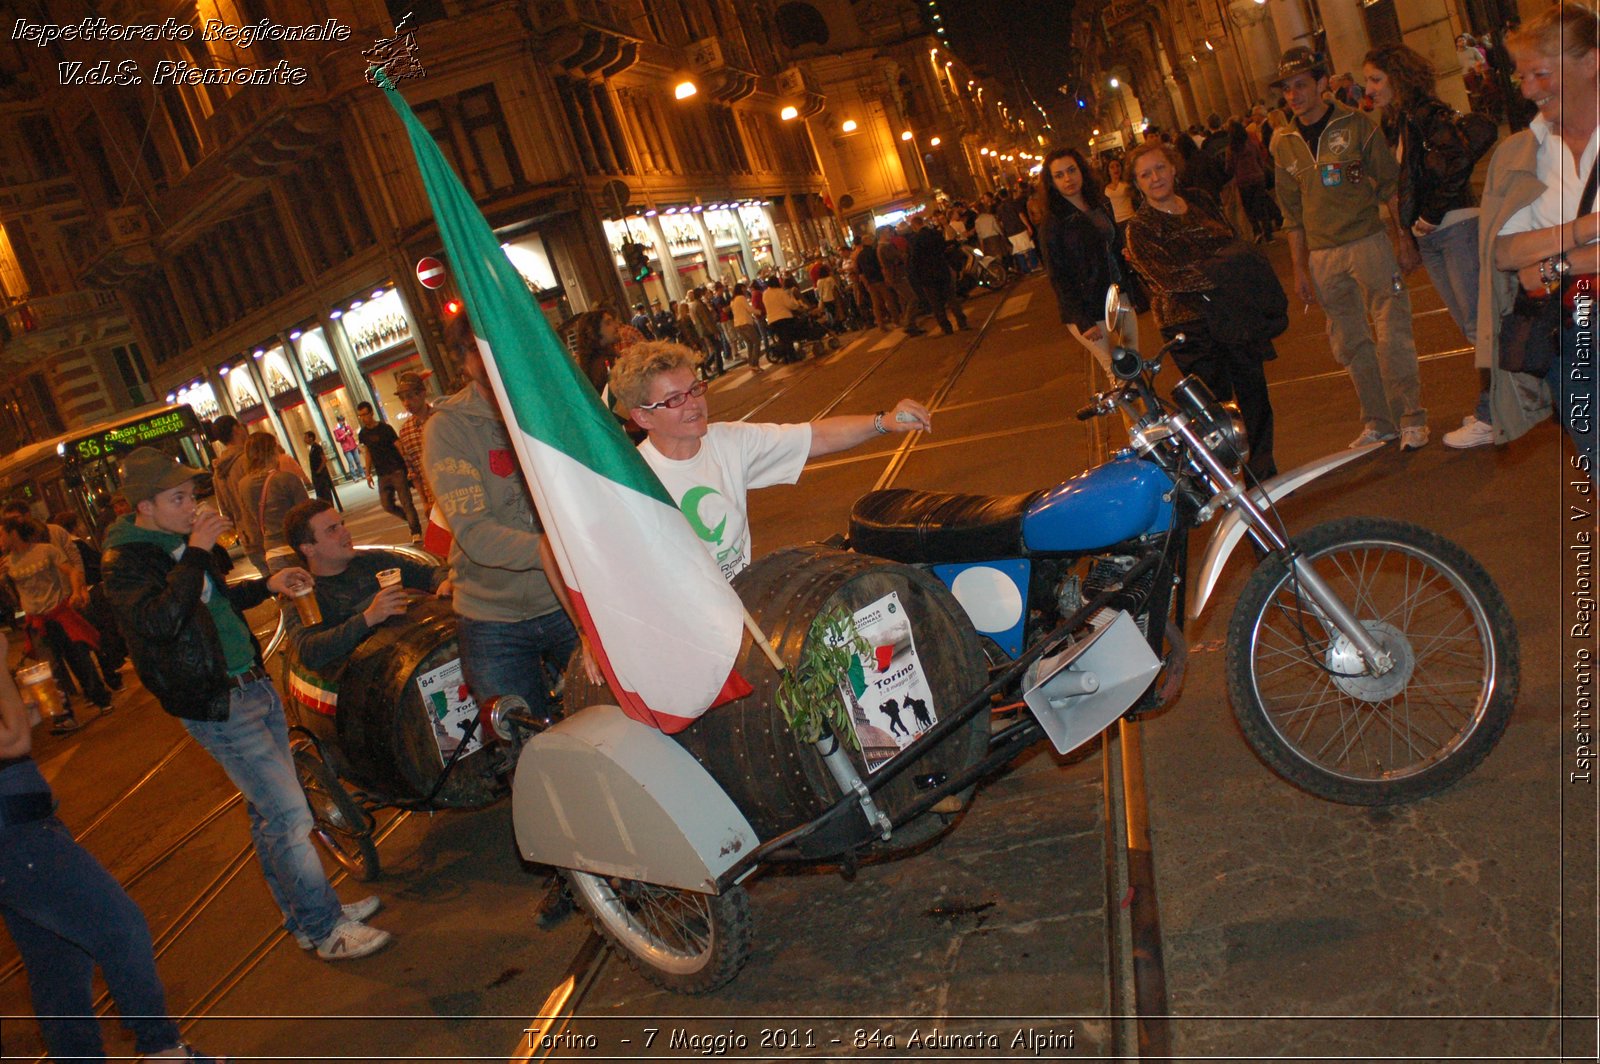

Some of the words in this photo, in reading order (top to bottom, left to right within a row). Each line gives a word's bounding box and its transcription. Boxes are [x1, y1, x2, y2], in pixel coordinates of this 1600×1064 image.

[78, 439, 100, 459] 56
[151, 412, 180, 428] SELLA
[138, 420, 184, 440] TABACCHI
[854, 609, 880, 625] DUNATA
[875, 663, 914, 689] Torino
